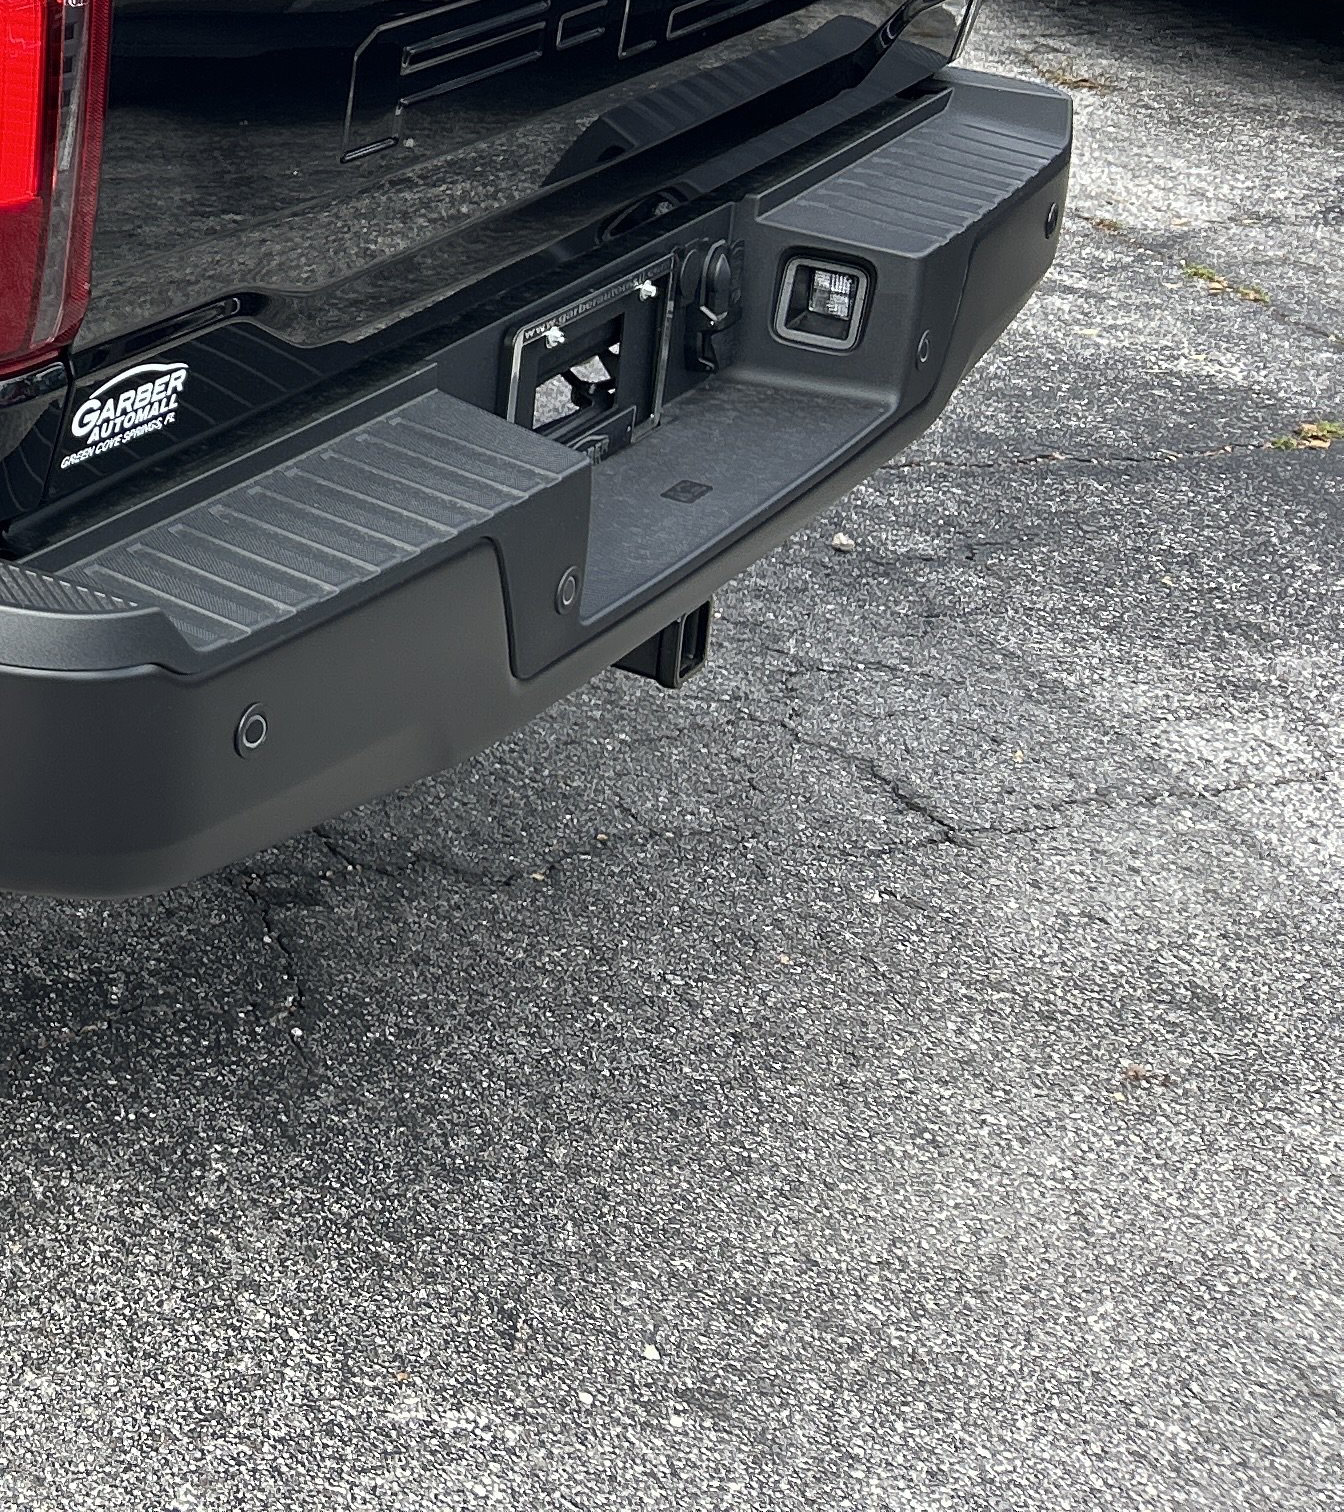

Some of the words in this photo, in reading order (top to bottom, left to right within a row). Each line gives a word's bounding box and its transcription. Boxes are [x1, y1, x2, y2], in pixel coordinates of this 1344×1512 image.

[71, 368, 187, 437] GARBER
[87, 393, 179, 445] AUTOMALL
[61, 446, 95, 469] GREEN
[95, 434, 123, 455] COVE
